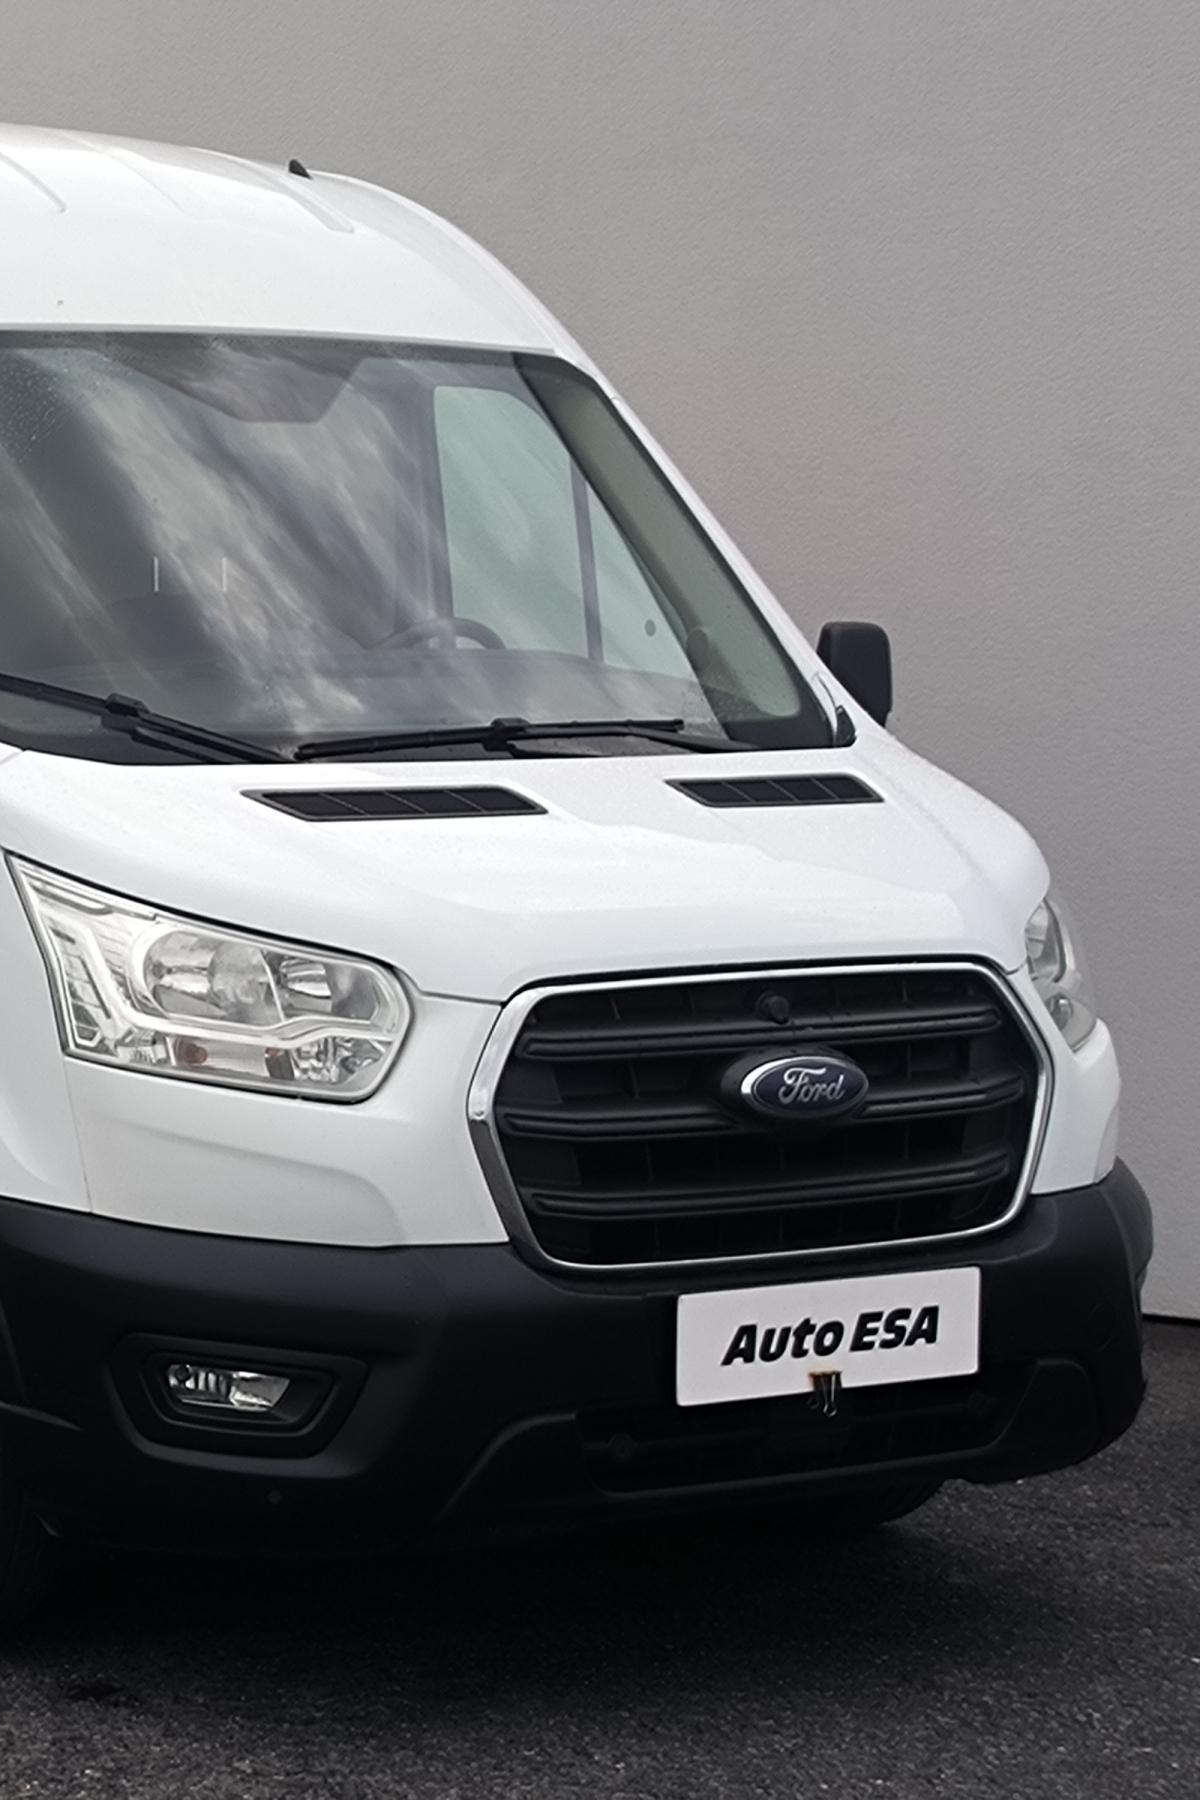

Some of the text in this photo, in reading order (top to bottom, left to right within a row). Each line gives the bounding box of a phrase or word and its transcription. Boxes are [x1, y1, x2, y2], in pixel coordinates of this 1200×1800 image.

[778, 1067, 845, 1104] Ford
[720, 1305, 939, 1366] Auto ESA
